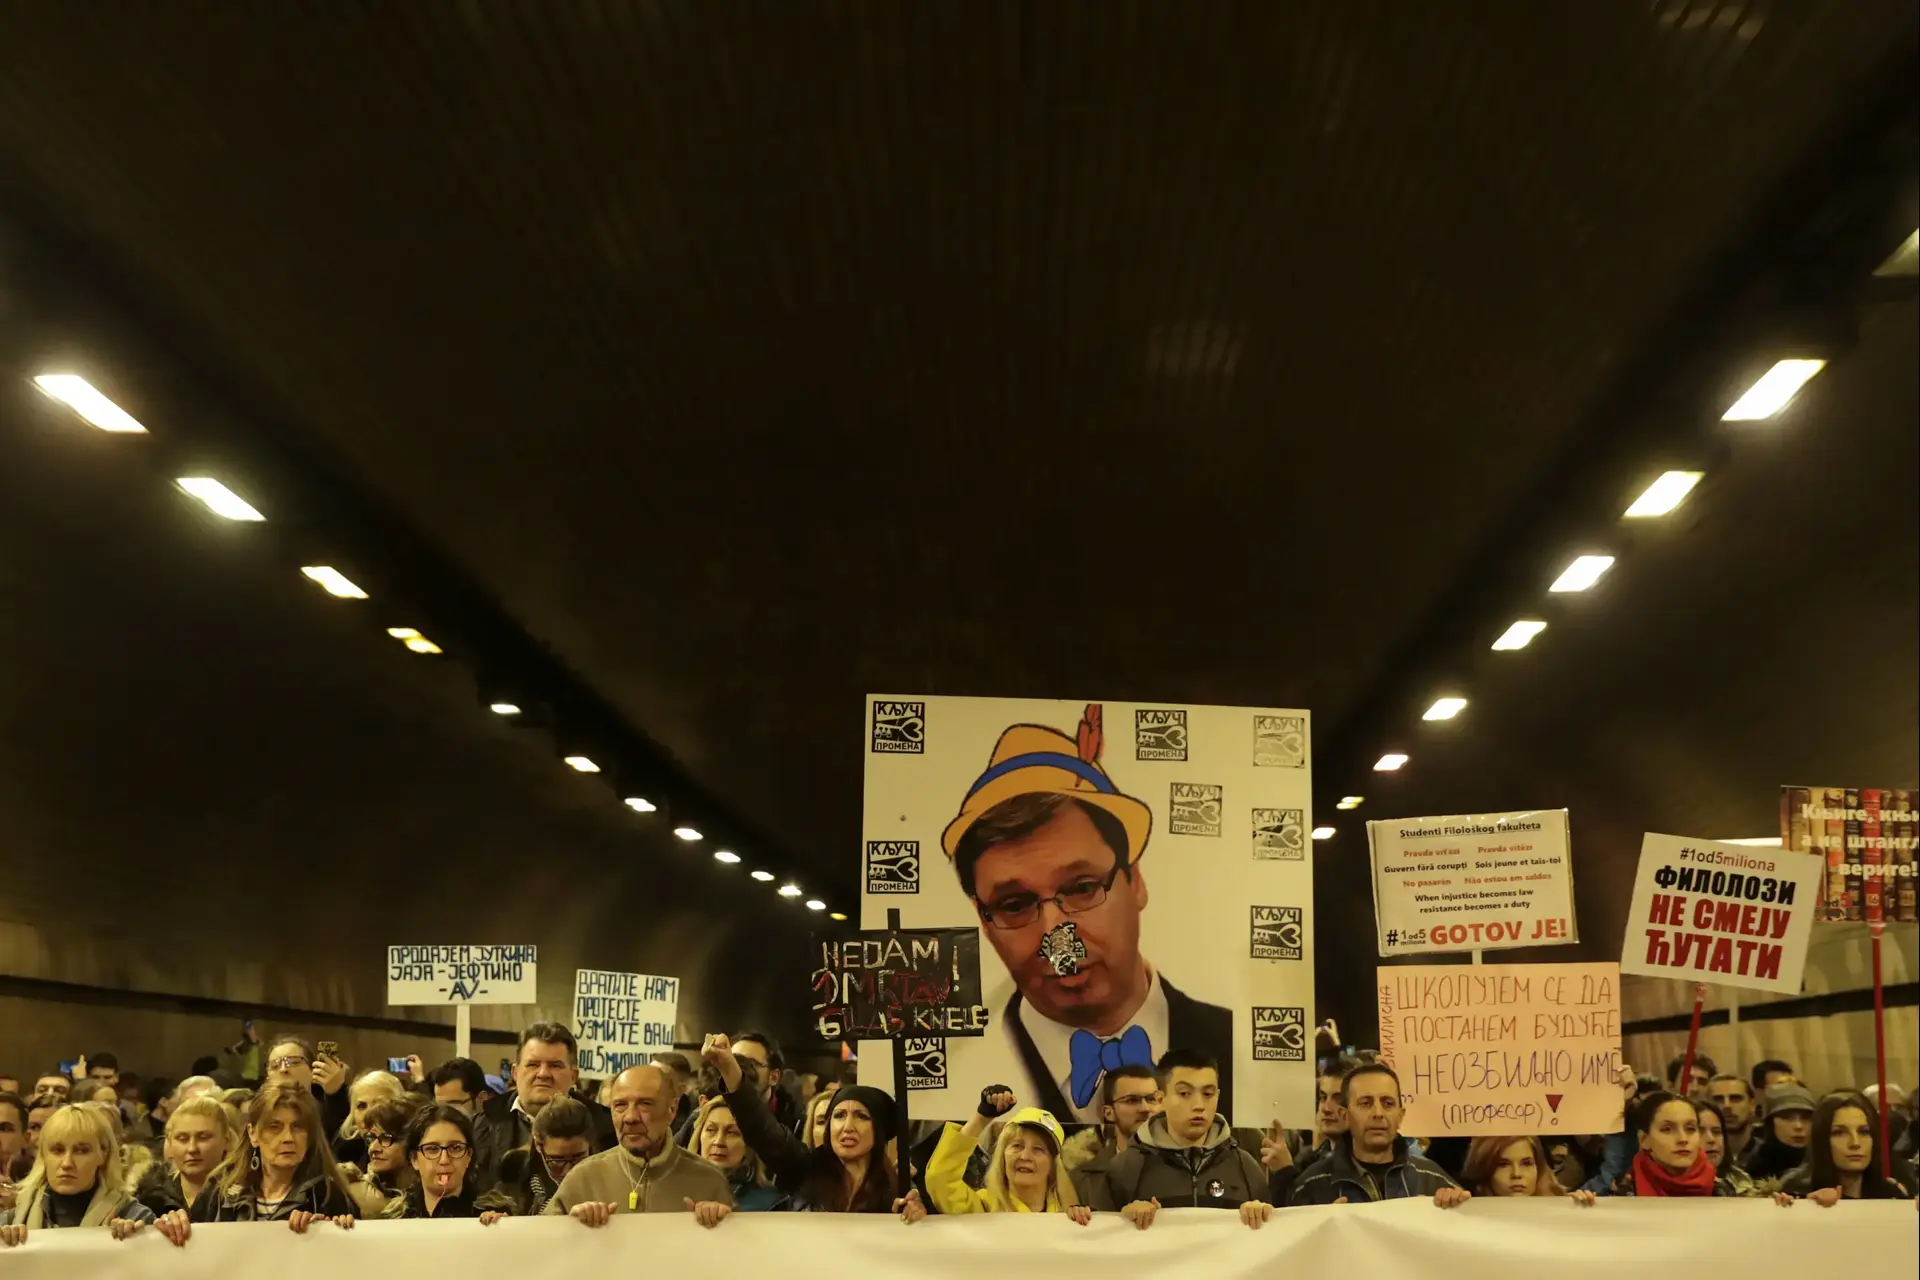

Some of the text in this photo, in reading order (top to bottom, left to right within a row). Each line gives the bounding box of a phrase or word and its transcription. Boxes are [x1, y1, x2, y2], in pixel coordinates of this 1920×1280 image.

[877, 702, 919, 717] КЉУЧ
[1140, 711, 1182, 724] КЉУЧ
[876, 742, 920, 750] ПРОМЕНА
[1140, 750, 1183, 758] ПРОМЕНА
[1400, 822, 1541, 838] Studenti Filološkog fakulteta
[1801, 835, 1812, 847] а
[1818, 836, 1842, 848] не
[871, 843, 914, 856] КЉУЧ
[1478, 845, 1507, 853] Pravda
[1475, 860, 1492, 868] Sois
[1494, 860, 1518, 869] jeune
[1530, 857, 1561, 865] tais-toi
[1680, 848, 1776, 872] #1od5miliona
[871, 882, 915, 891] ПРОМЕНА
[1655, 865, 1797, 905] ФИЛОЛОЗИ
[1415, 894, 1440, 902] When
[1442, 892, 1477, 902] injustice
[1479, 890, 1517, 898] becomes
[1420, 904, 1462, 913] resistance
[1464, 902, 1501, 910] becomes
[1511, 900, 1531, 909] duty
[1255, 908, 1297, 922] КЉУЧ
[1648, 893, 1791, 939] НЕ СМЕЈУ
[1430, 918, 1567, 945] GOTOV JE!
[391, 946, 470, 964] ПРОДАЈЕМ
[1254, 948, 1298, 956] ПРОМЕНА
[1645, 929, 1783, 980] ЋУТАТИ
[390, 964, 434, 981] ЈАЈА
[448, 961, 523, 982] ЈЕФТИНО
[579, 971, 676, 1003] ВРАТИТЕ НАМ
[1396, 974, 1612, 1010] ШКОЛУЈЕМ СЕ ДА
[577, 997, 641, 1021] ПРОТЕСТЕ
[1257, 1009, 1299, 1023] КЉУЧ
[574, 1019, 674, 1046] УЗМИТЕ ВАШ
[1403, 1009, 1621, 1043] ПОСТАНЕМ БУДУЋЕ
[906, 1038, 940, 1051] ЉУЧ
[1257, 1050, 1301, 1058] ПРОМЕНА
[906, 1078, 942, 1087] РОМЕНА
